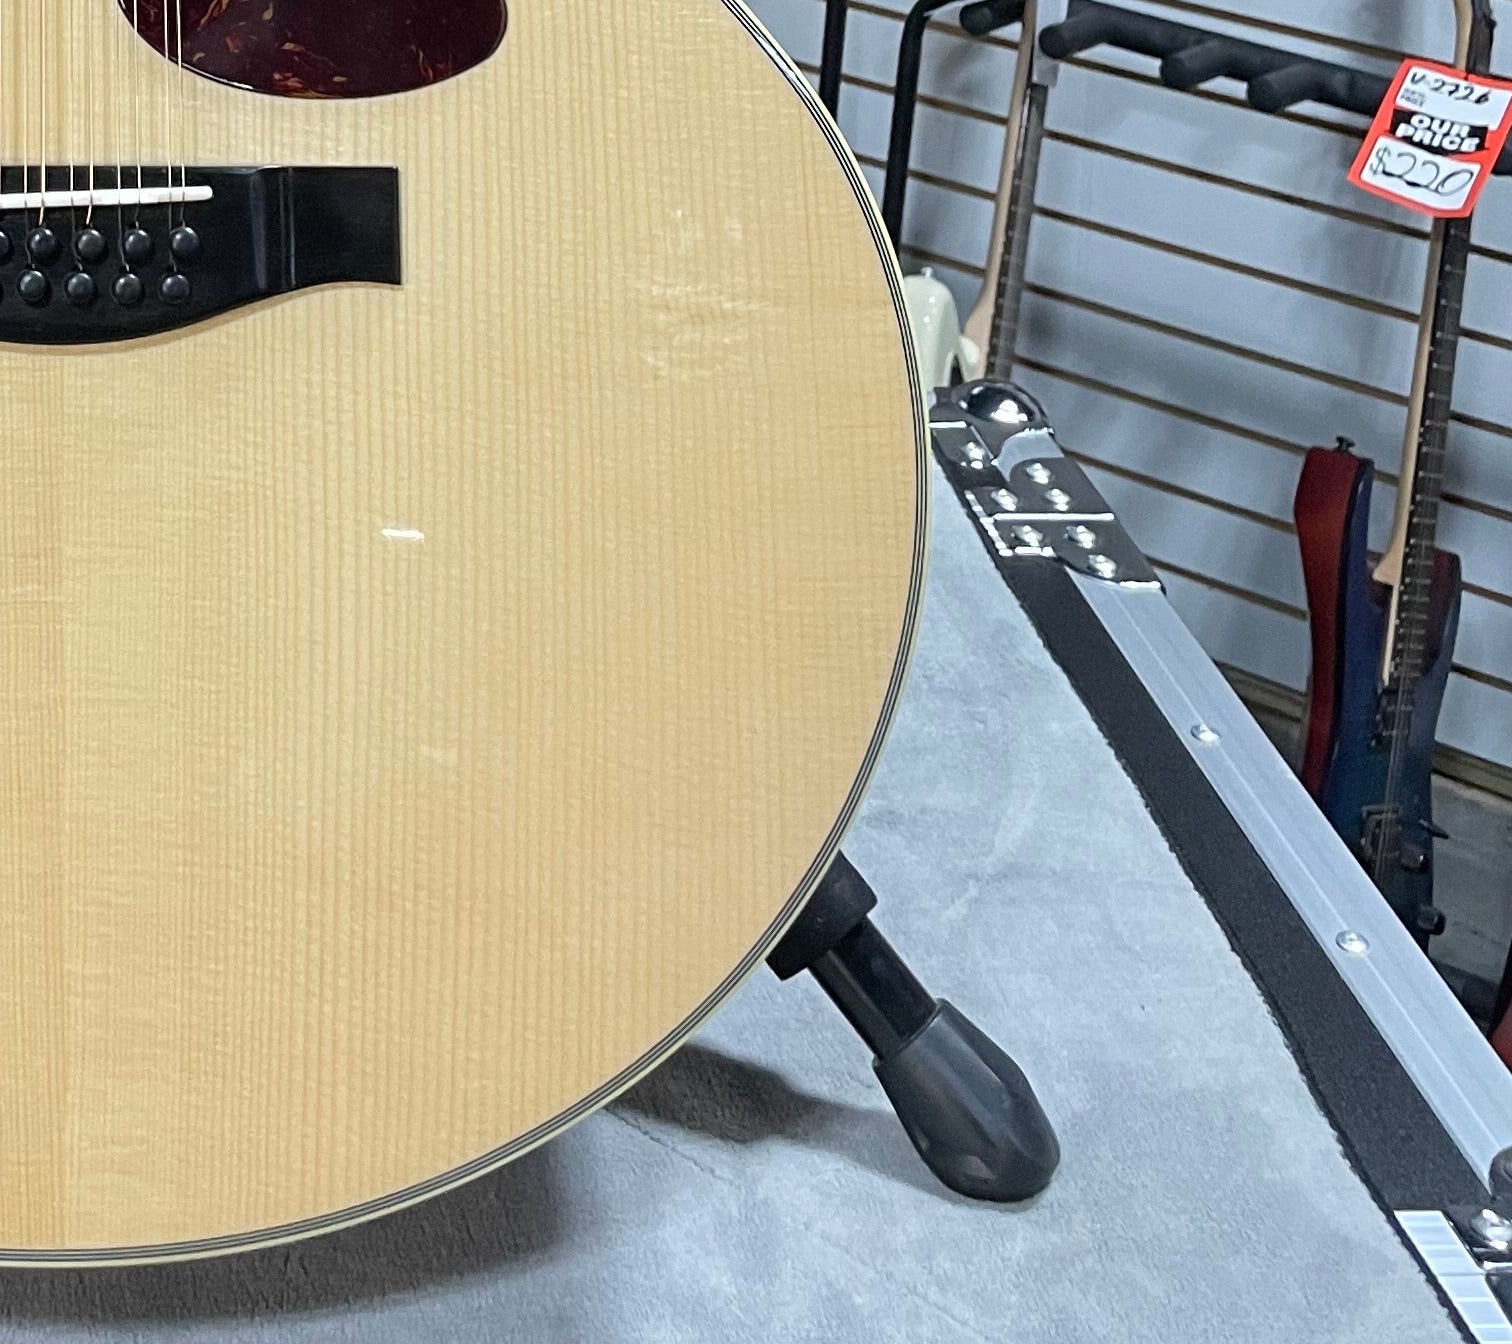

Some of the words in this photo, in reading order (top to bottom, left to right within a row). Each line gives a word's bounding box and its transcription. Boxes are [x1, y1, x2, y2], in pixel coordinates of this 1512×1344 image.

[1395, 122, 1481, 153] PRICE
[1410, 113, 1471, 139] OUR
[1369, 145, 1475, 197] $220
